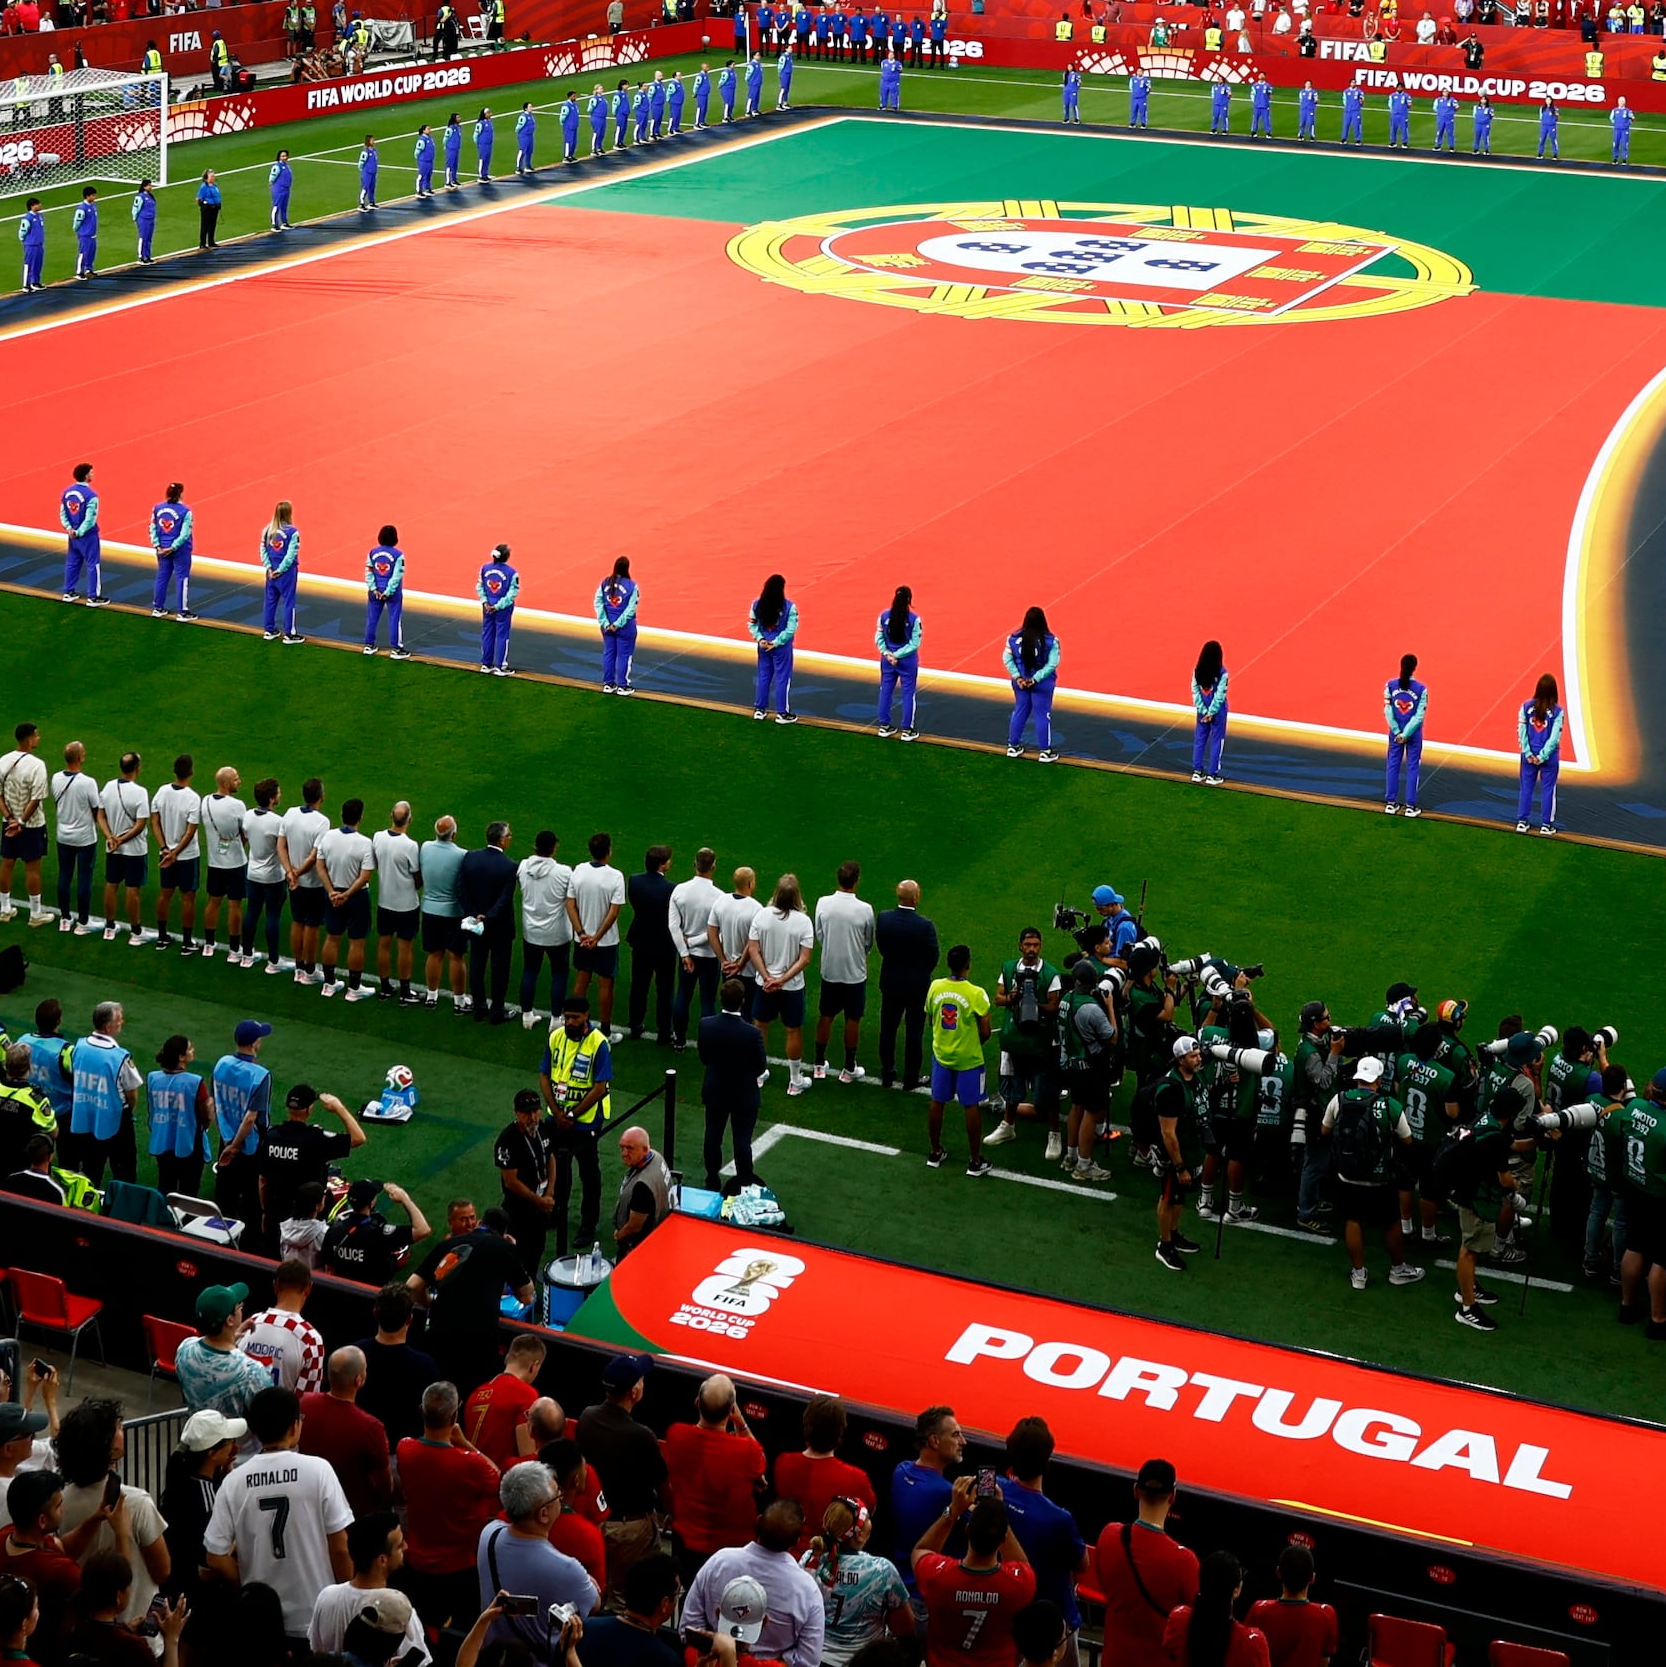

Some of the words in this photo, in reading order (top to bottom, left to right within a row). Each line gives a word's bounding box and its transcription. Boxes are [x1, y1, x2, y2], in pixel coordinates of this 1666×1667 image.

[170, 31, 202, 53] FIFA
[1320, 40, 1372, 61] FIFA
[308, 87, 339, 110] FIFA
[341, 79, 394, 103] WORLD
[395, 75, 423, 95] CUP
[423, 67, 471, 90] 2026
[1355, 69, 1399, 87] FIFA
[1402, 72, 1484, 95] WORLD
[1486, 78, 1526, 97] CUP
[1528, 82, 1606, 102] 2026
[74, 1069, 110, 1095] FIFA
[153, 1091, 186, 1113] FIFA
[1631, 1108, 1658, 1128] PHOTO
[268, 1144, 299, 1161] POLICE
[713, 1294, 746, 1308] FIFA
[669, 1311, 749, 1340] 2026
[680, 1304, 727, 1321] WORLD
[728, 1315, 756, 1327] CUP
[944, 1322, 1573, 1500] PORTUGAL
[471, 1403, 491, 1446] 7
[246, 1468, 298, 1489] RONALDO
[259, 1496, 289, 1560] 7
[955, 1590, 999, 1605] RONALDO
[961, 1609, 989, 1650] 7
